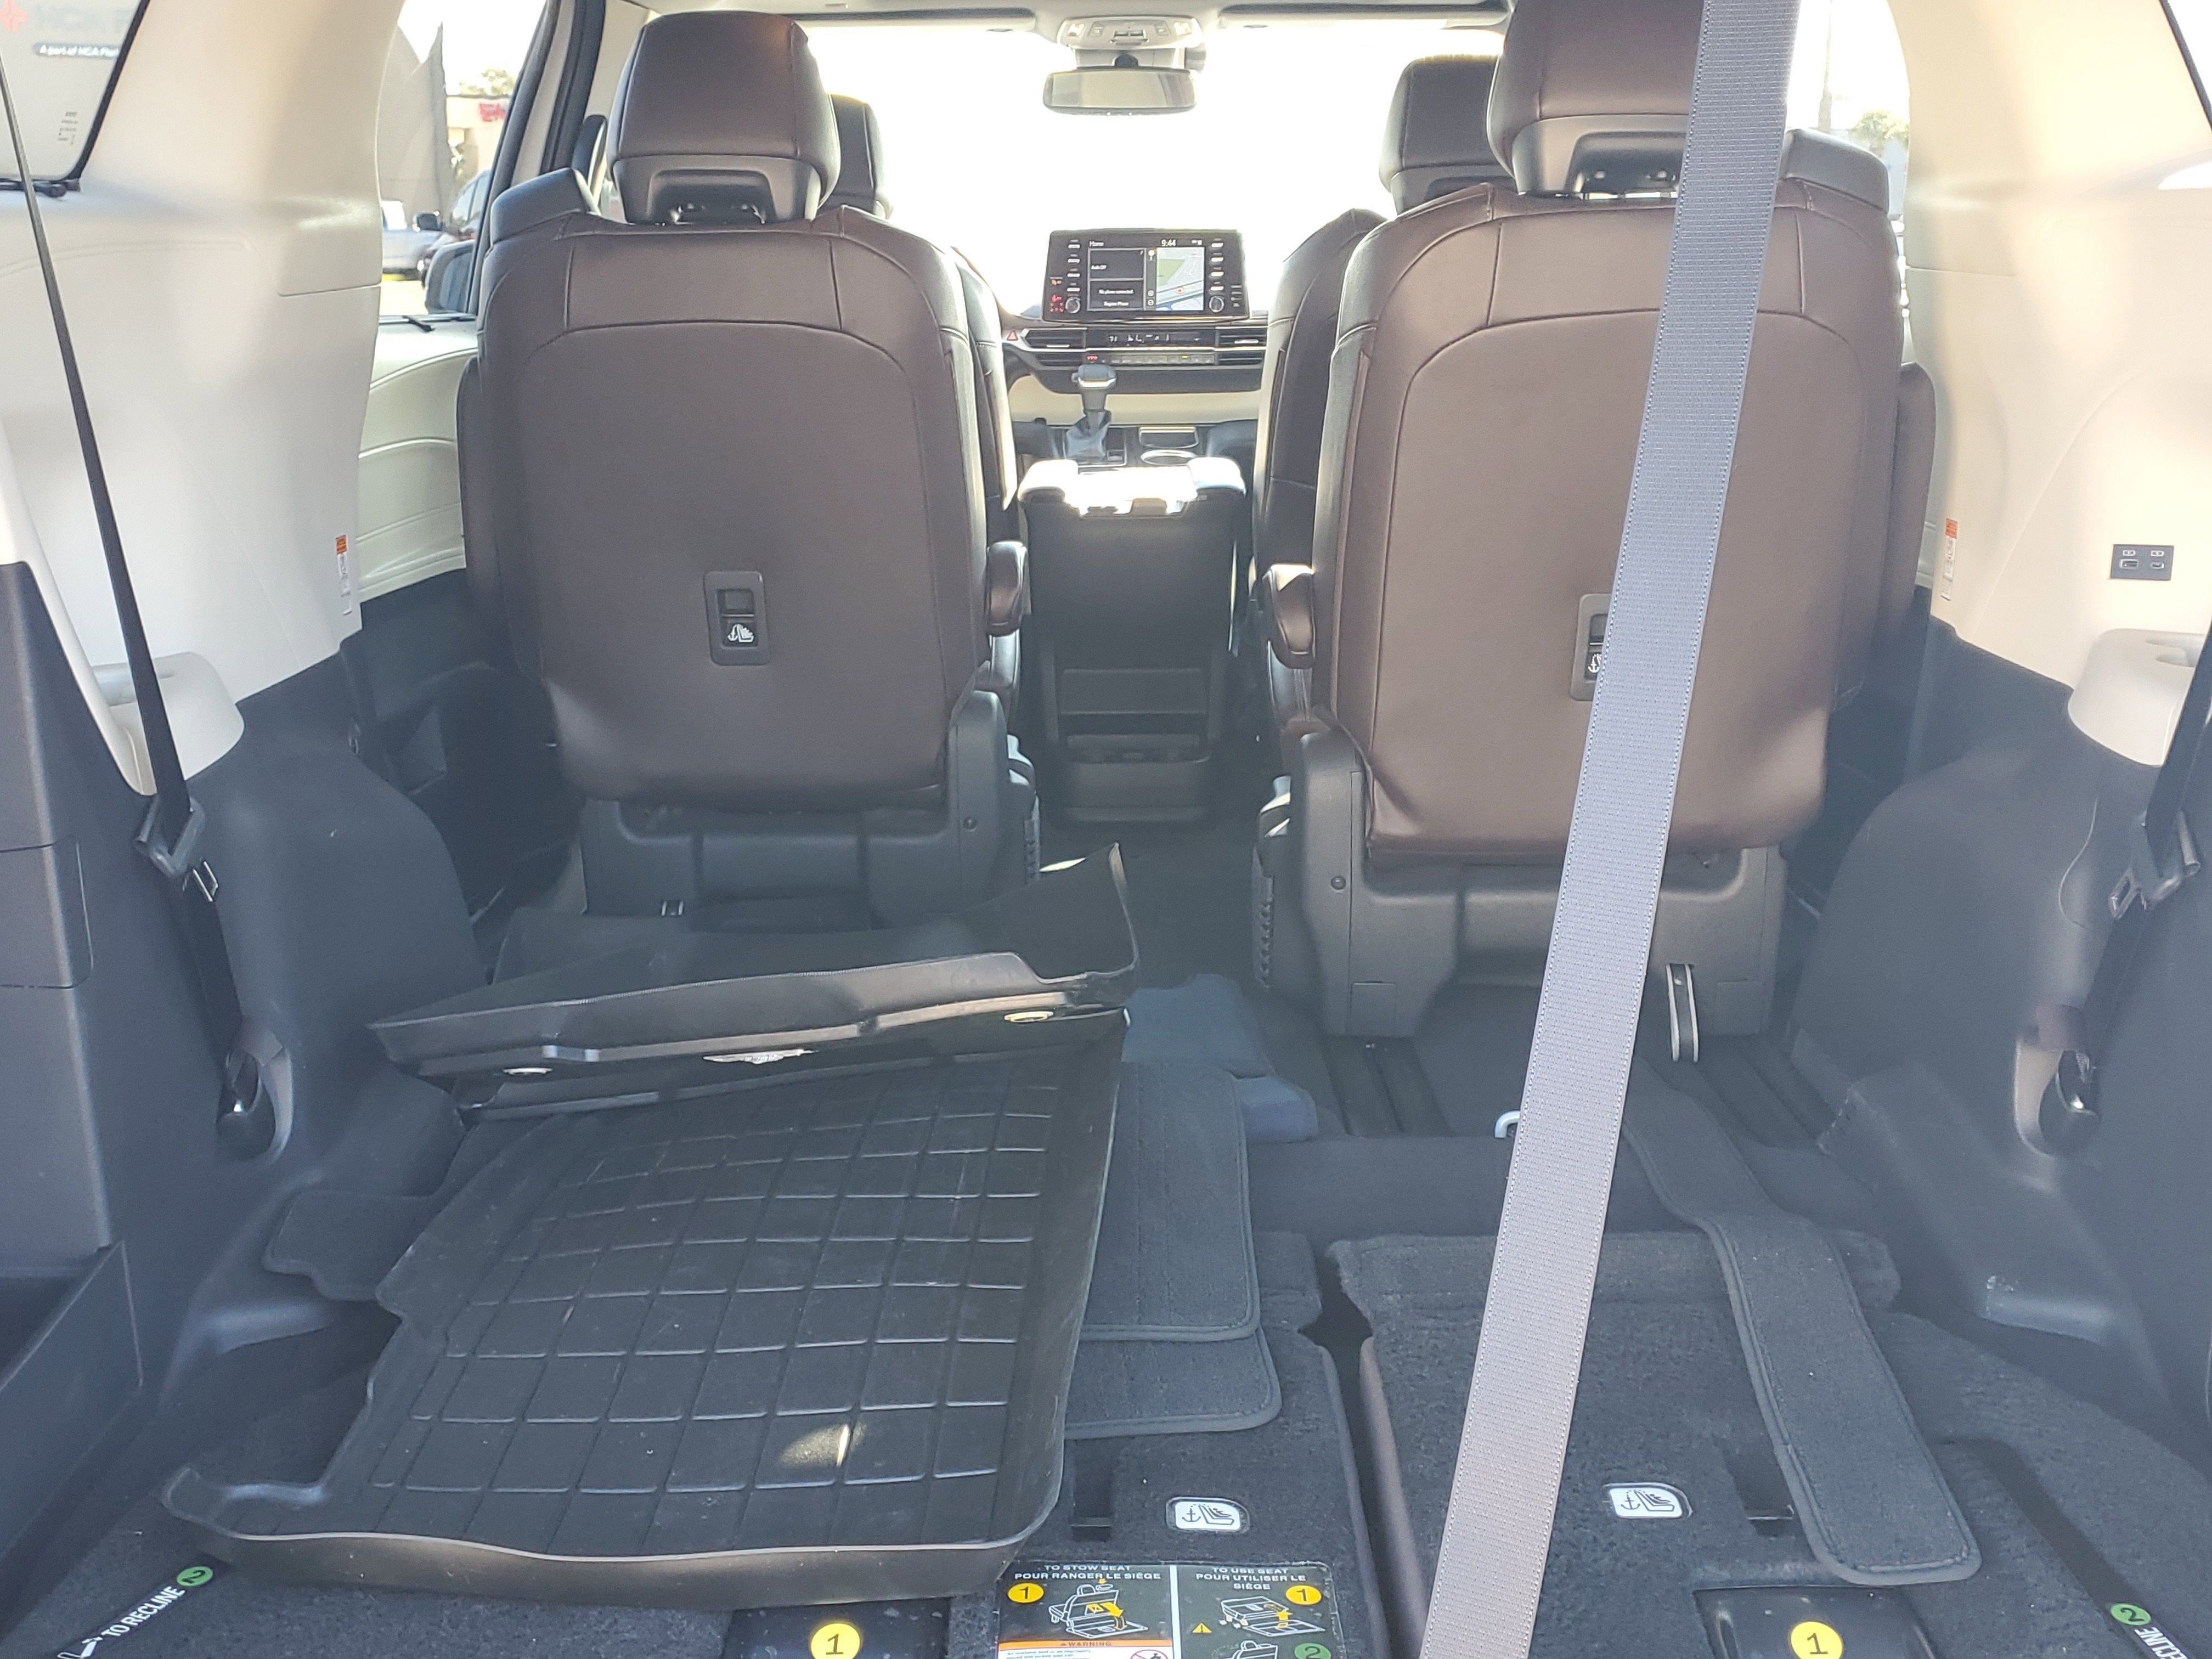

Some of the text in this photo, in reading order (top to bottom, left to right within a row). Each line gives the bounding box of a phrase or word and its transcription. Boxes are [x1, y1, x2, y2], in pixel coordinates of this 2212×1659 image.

[1019, 1586, 1029, 1600] 1
[1233, 1582, 1271, 1590] SIÈGE
[1296, 1588, 1308, 1602] 1
[101, 1570, 206, 1637] TO RECLINE 2
[2120, 1607, 2145, 1622] 2
[826, 1633, 844, 1655] 1
[1807, 1632, 1829, 1655] 1
